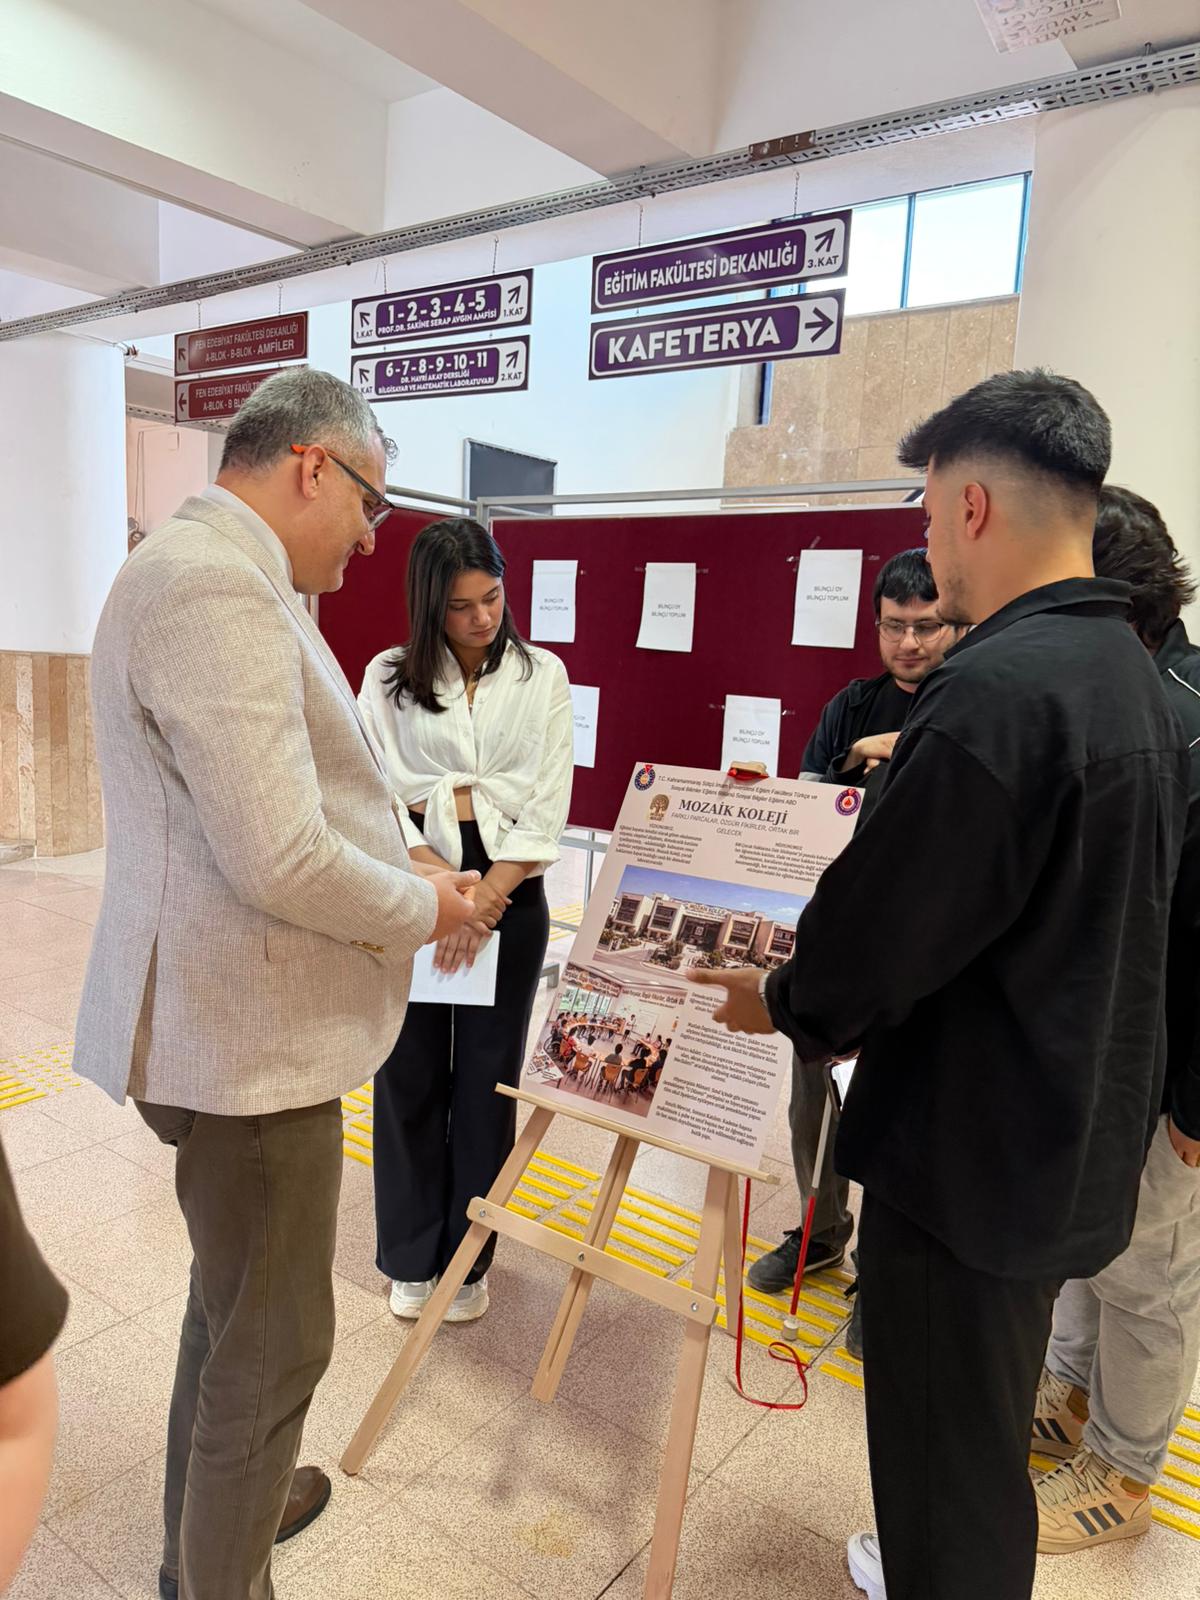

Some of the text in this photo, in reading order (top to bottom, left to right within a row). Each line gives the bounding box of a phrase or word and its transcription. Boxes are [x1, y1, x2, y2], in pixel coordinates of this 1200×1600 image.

[604, 240, 798, 296] EĞİTİM FAKÜLTESİ DEKANLIĞI
[807, 255, 839, 269] 3.KAT
[504, 306, 524, 318] 1.KAT
[407, 319, 430, 332] SAKİNE
[430, 317, 451, 327] SERAP
[473, 309, 497, 321] AMFİSİ
[207, 334, 234, 348] EDEBİYAT
[234, 328, 265, 345] FAKÜLTESİ
[266, 321, 298, 338] DEKANLIĞI
[356, 329, 373, 339] 1.KAT
[607, 316, 780, 364] KAFETERYA
[257, 339, 295, 354] AMFİLER
[501, 371, 522, 381] 2.KAT
[195, 388, 207, 398] FEN
[207, 383, 234, 397] EDEBİYAT
[409, 384, 417, 392] VE
[417, 380, 450, 391] MATEMATİK
[679, 799, 733, 817] MOZAİK
[736, 806, 788, 825] KOLEJİ
[716, 828, 743, 836] GELECEK
[768, 825, 788, 834] ORTAK
